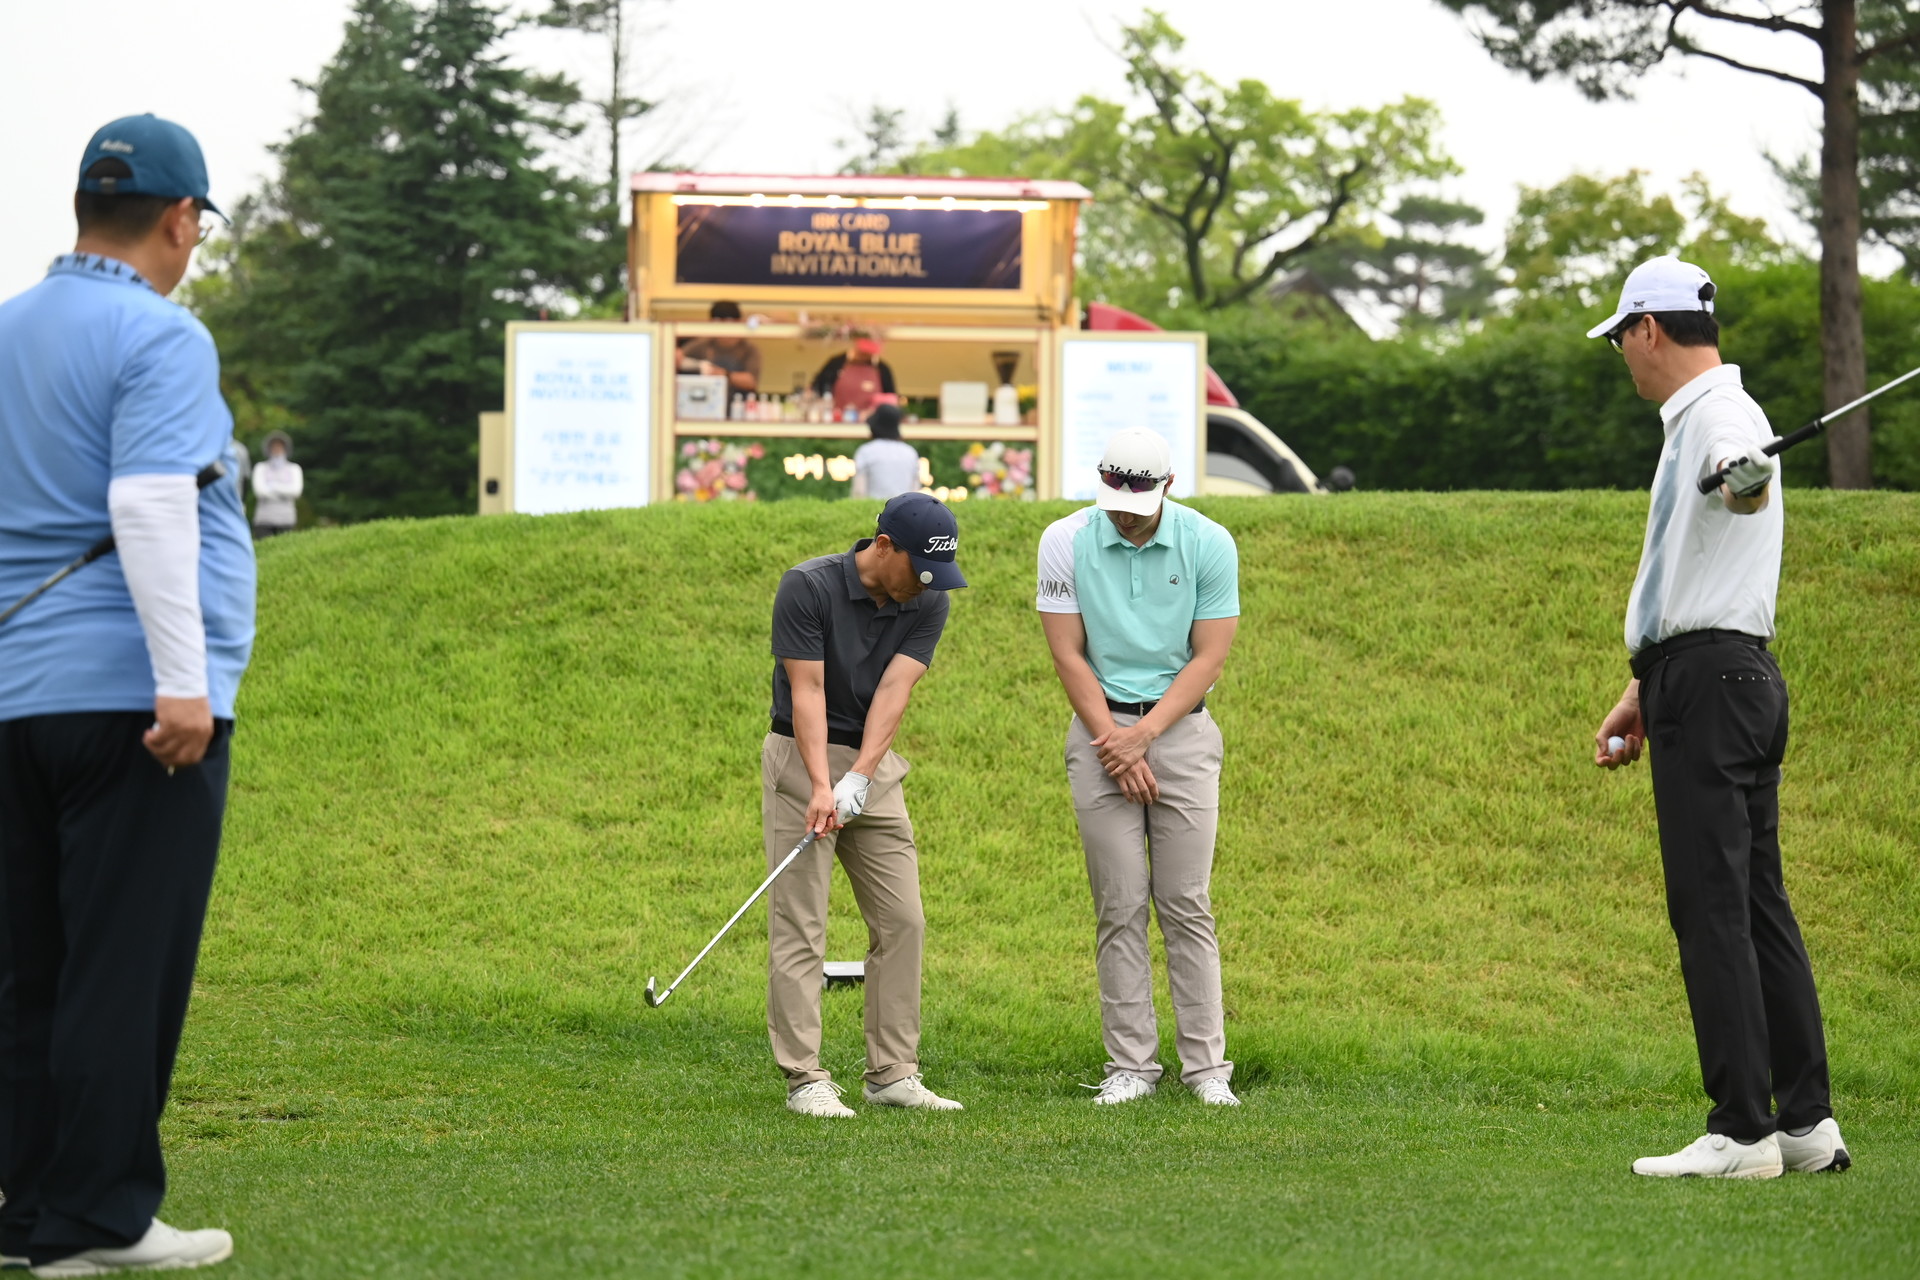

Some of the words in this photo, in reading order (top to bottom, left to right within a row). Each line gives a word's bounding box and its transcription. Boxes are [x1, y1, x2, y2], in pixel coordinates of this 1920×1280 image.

[841, 213, 890, 232] CARD
[778, 231, 855, 253] ROYAL
[860, 232, 921, 255] BLUE
[770, 253, 928, 278] INVITATIONAL
[1109, 464, 1152, 480] Vlik
